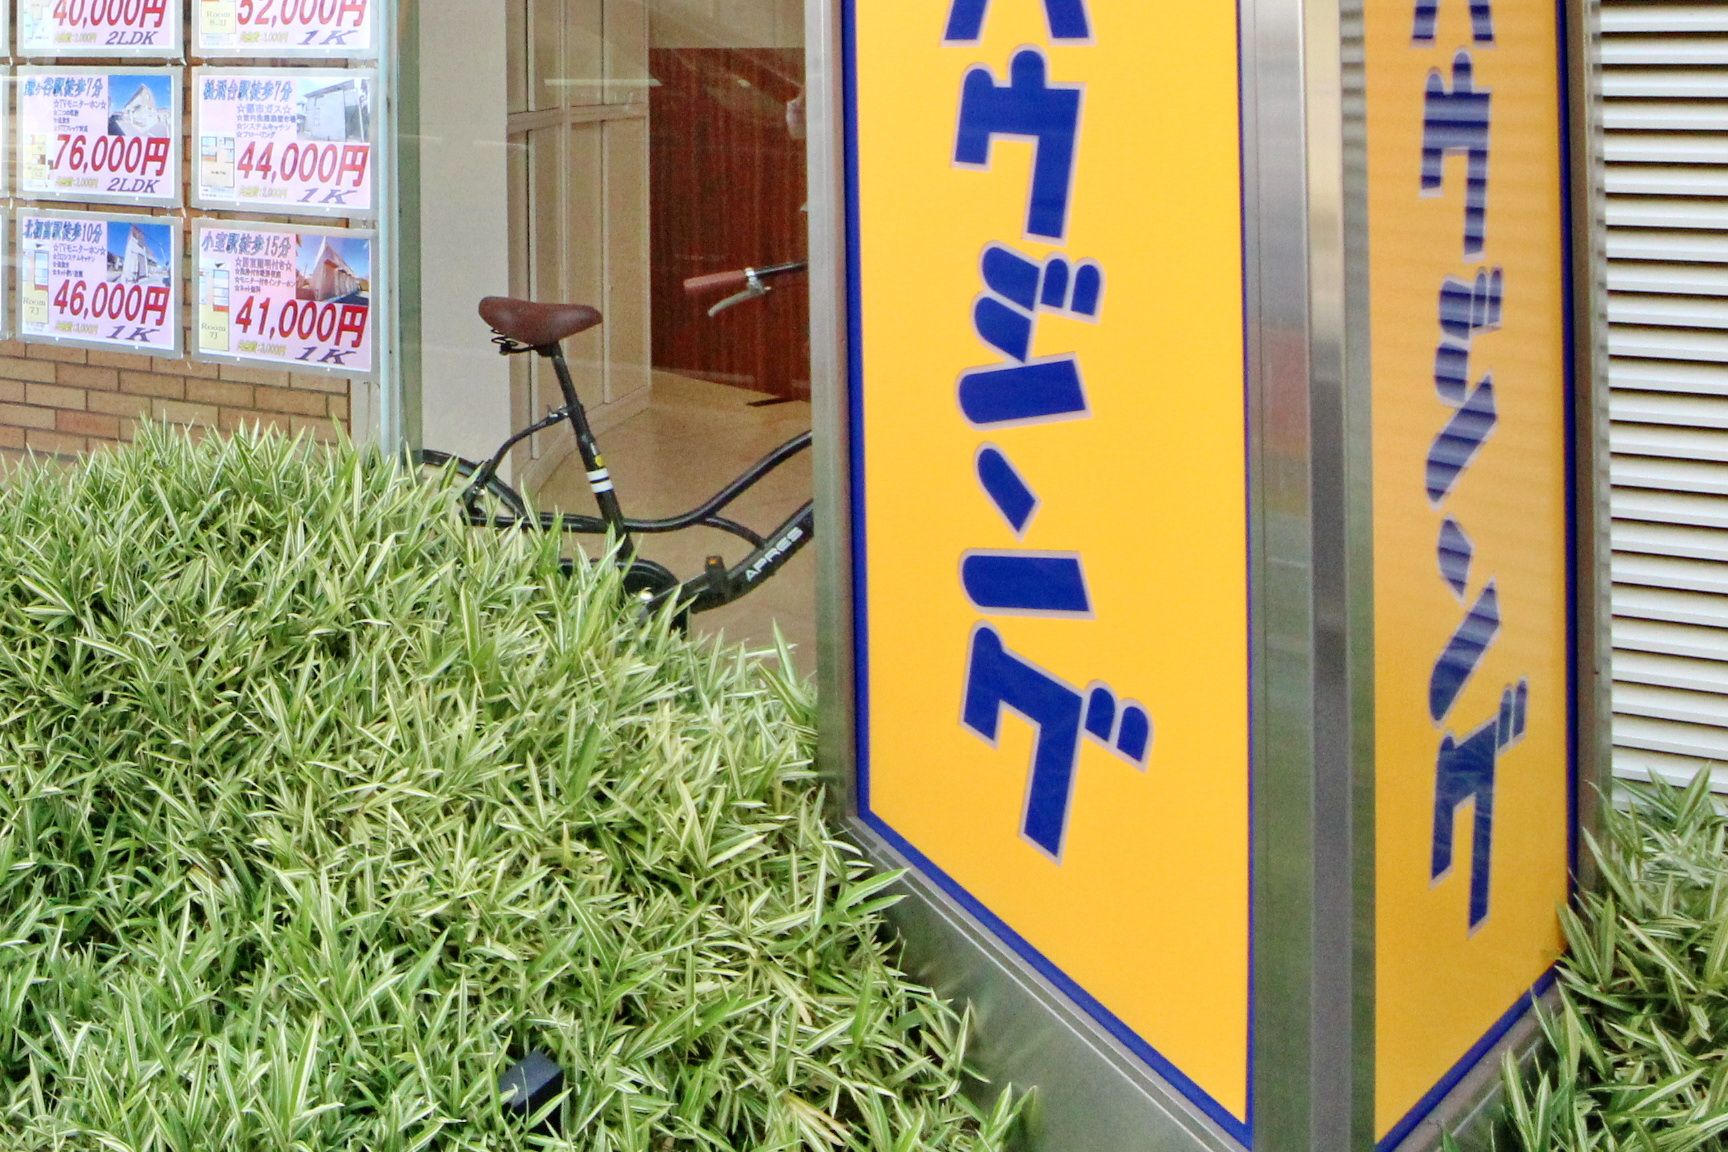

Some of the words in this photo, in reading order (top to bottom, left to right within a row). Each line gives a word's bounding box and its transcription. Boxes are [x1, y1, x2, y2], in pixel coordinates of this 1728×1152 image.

[105, 31, 159, 45] 2LDK
[297, 30, 359, 45] 1K
[53, 134, 170, 176] 76,000円
[237, 141, 370, 187] 44,000円
[107, 177, 160, 193] 2LDK
[297, 188, 358, 204] 1K
[53, 279, 170, 326] 46,000円
[235, 295, 369, 348] 41,000円
[106, 325, 160, 342] 1K
[295, 347, 357, 365] 1K
